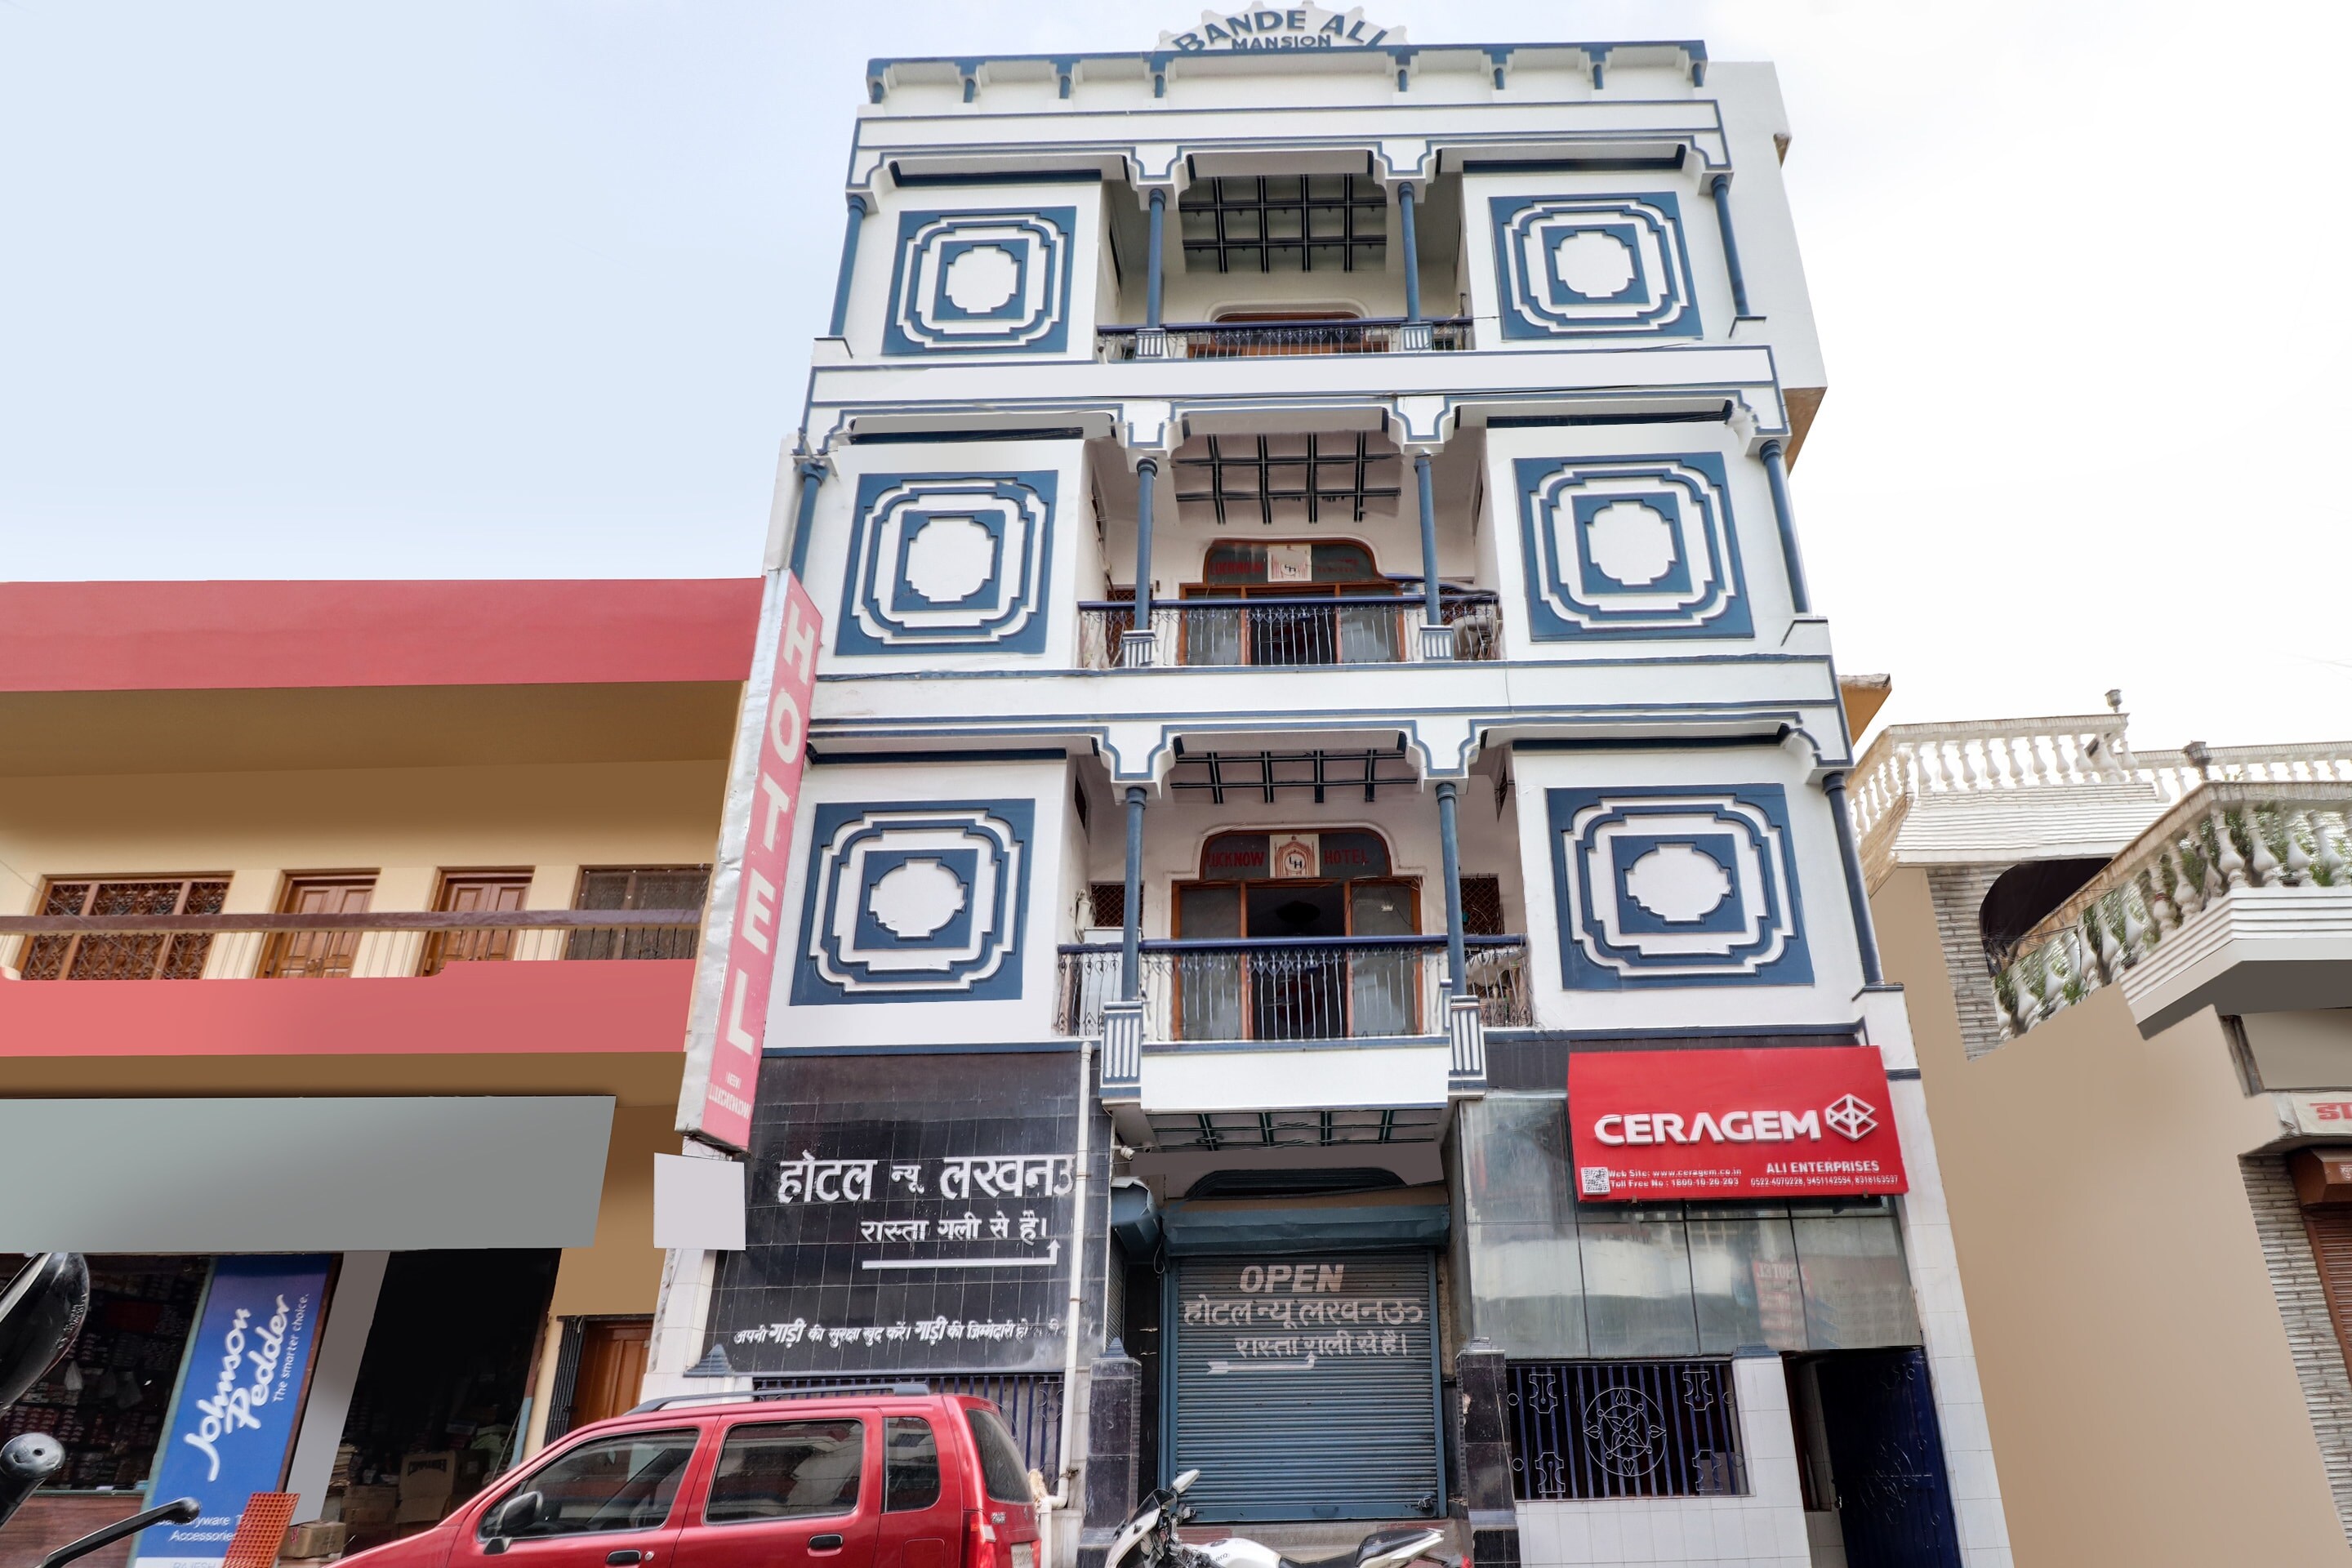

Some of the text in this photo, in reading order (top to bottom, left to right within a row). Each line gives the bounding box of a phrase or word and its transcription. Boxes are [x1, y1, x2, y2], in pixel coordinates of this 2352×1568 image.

[1172, 10, 1389, 51] BANDE ALI
[1232, 34, 1331, 50] MANSION
[724, 599, 816, 1058] HOTEL
[1324, 849, 1371, 865] HOTEL
[1593, 1109, 1823, 1147] CERAGEM
[777, 1149, 879, 1204] होटल
[890, 1165, 925, 1195] न्यू
[1610, 1179, 1626, 1188] Toll
[1628, 1178, 1649, 1188] Free
[1652, 1167, 1742, 1178] www.ceragem.co.in
[1766, 1160, 1880, 1174] ALI ENTERPRISES
[860, 1219, 930, 1243] रास्ता
[937, 1210, 982, 1241] गली
[989, 1209, 1010, 1240] से
[1239, 1263, 1345, 1294] OPEN
[1184, 1293, 1423, 1330] होटल न्यू लखनऊ
[272, 1293, 310, 1403] The smarter choice.
[733, 1324, 768, 1345] अपनी
[828, 1326, 862, 1348] सुरक्षा
[862, 1326, 885, 1348] खुद
[1235, 1336, 1299, 1358] रास्ता
[1303, 1329, 1355, 1357] गली
[1356, 1330, 1379, 1356] से
[225, 1294, 290, 1435] Pedder
[184, 1307, 252, 1483] Johnson
